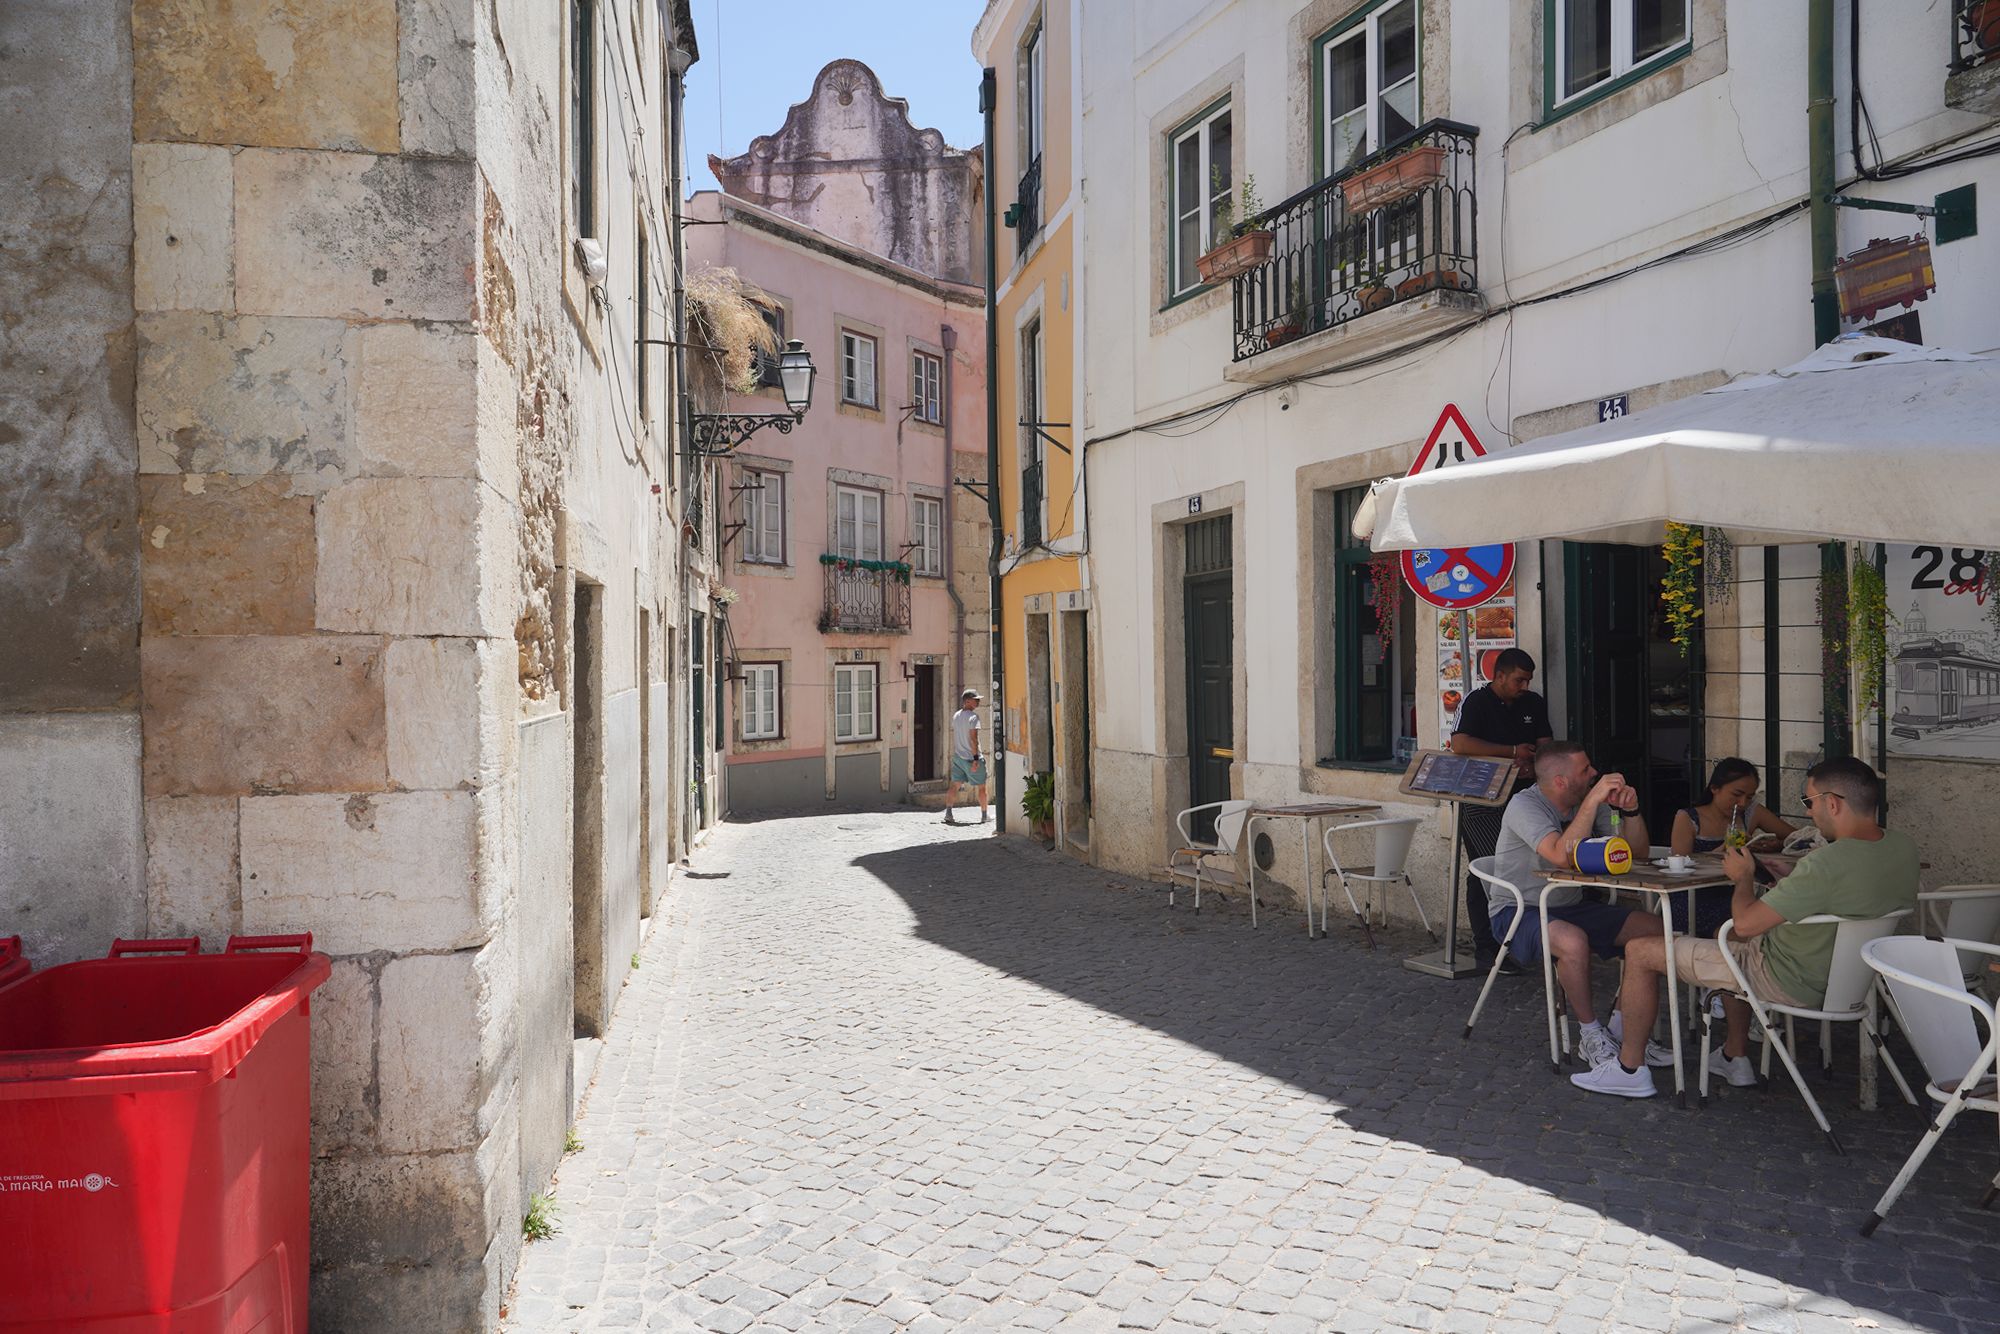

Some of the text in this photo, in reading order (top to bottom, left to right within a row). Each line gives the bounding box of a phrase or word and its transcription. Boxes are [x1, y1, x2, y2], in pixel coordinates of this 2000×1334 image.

[1603, 398, 1623, 422] 45
[1911, 545, 1985, 590] 28
[1943, 565, 1990, 606] caf
[1610, 852, 1627, 862] Lipton
[10, 1181, 54, 1192] MARIA
